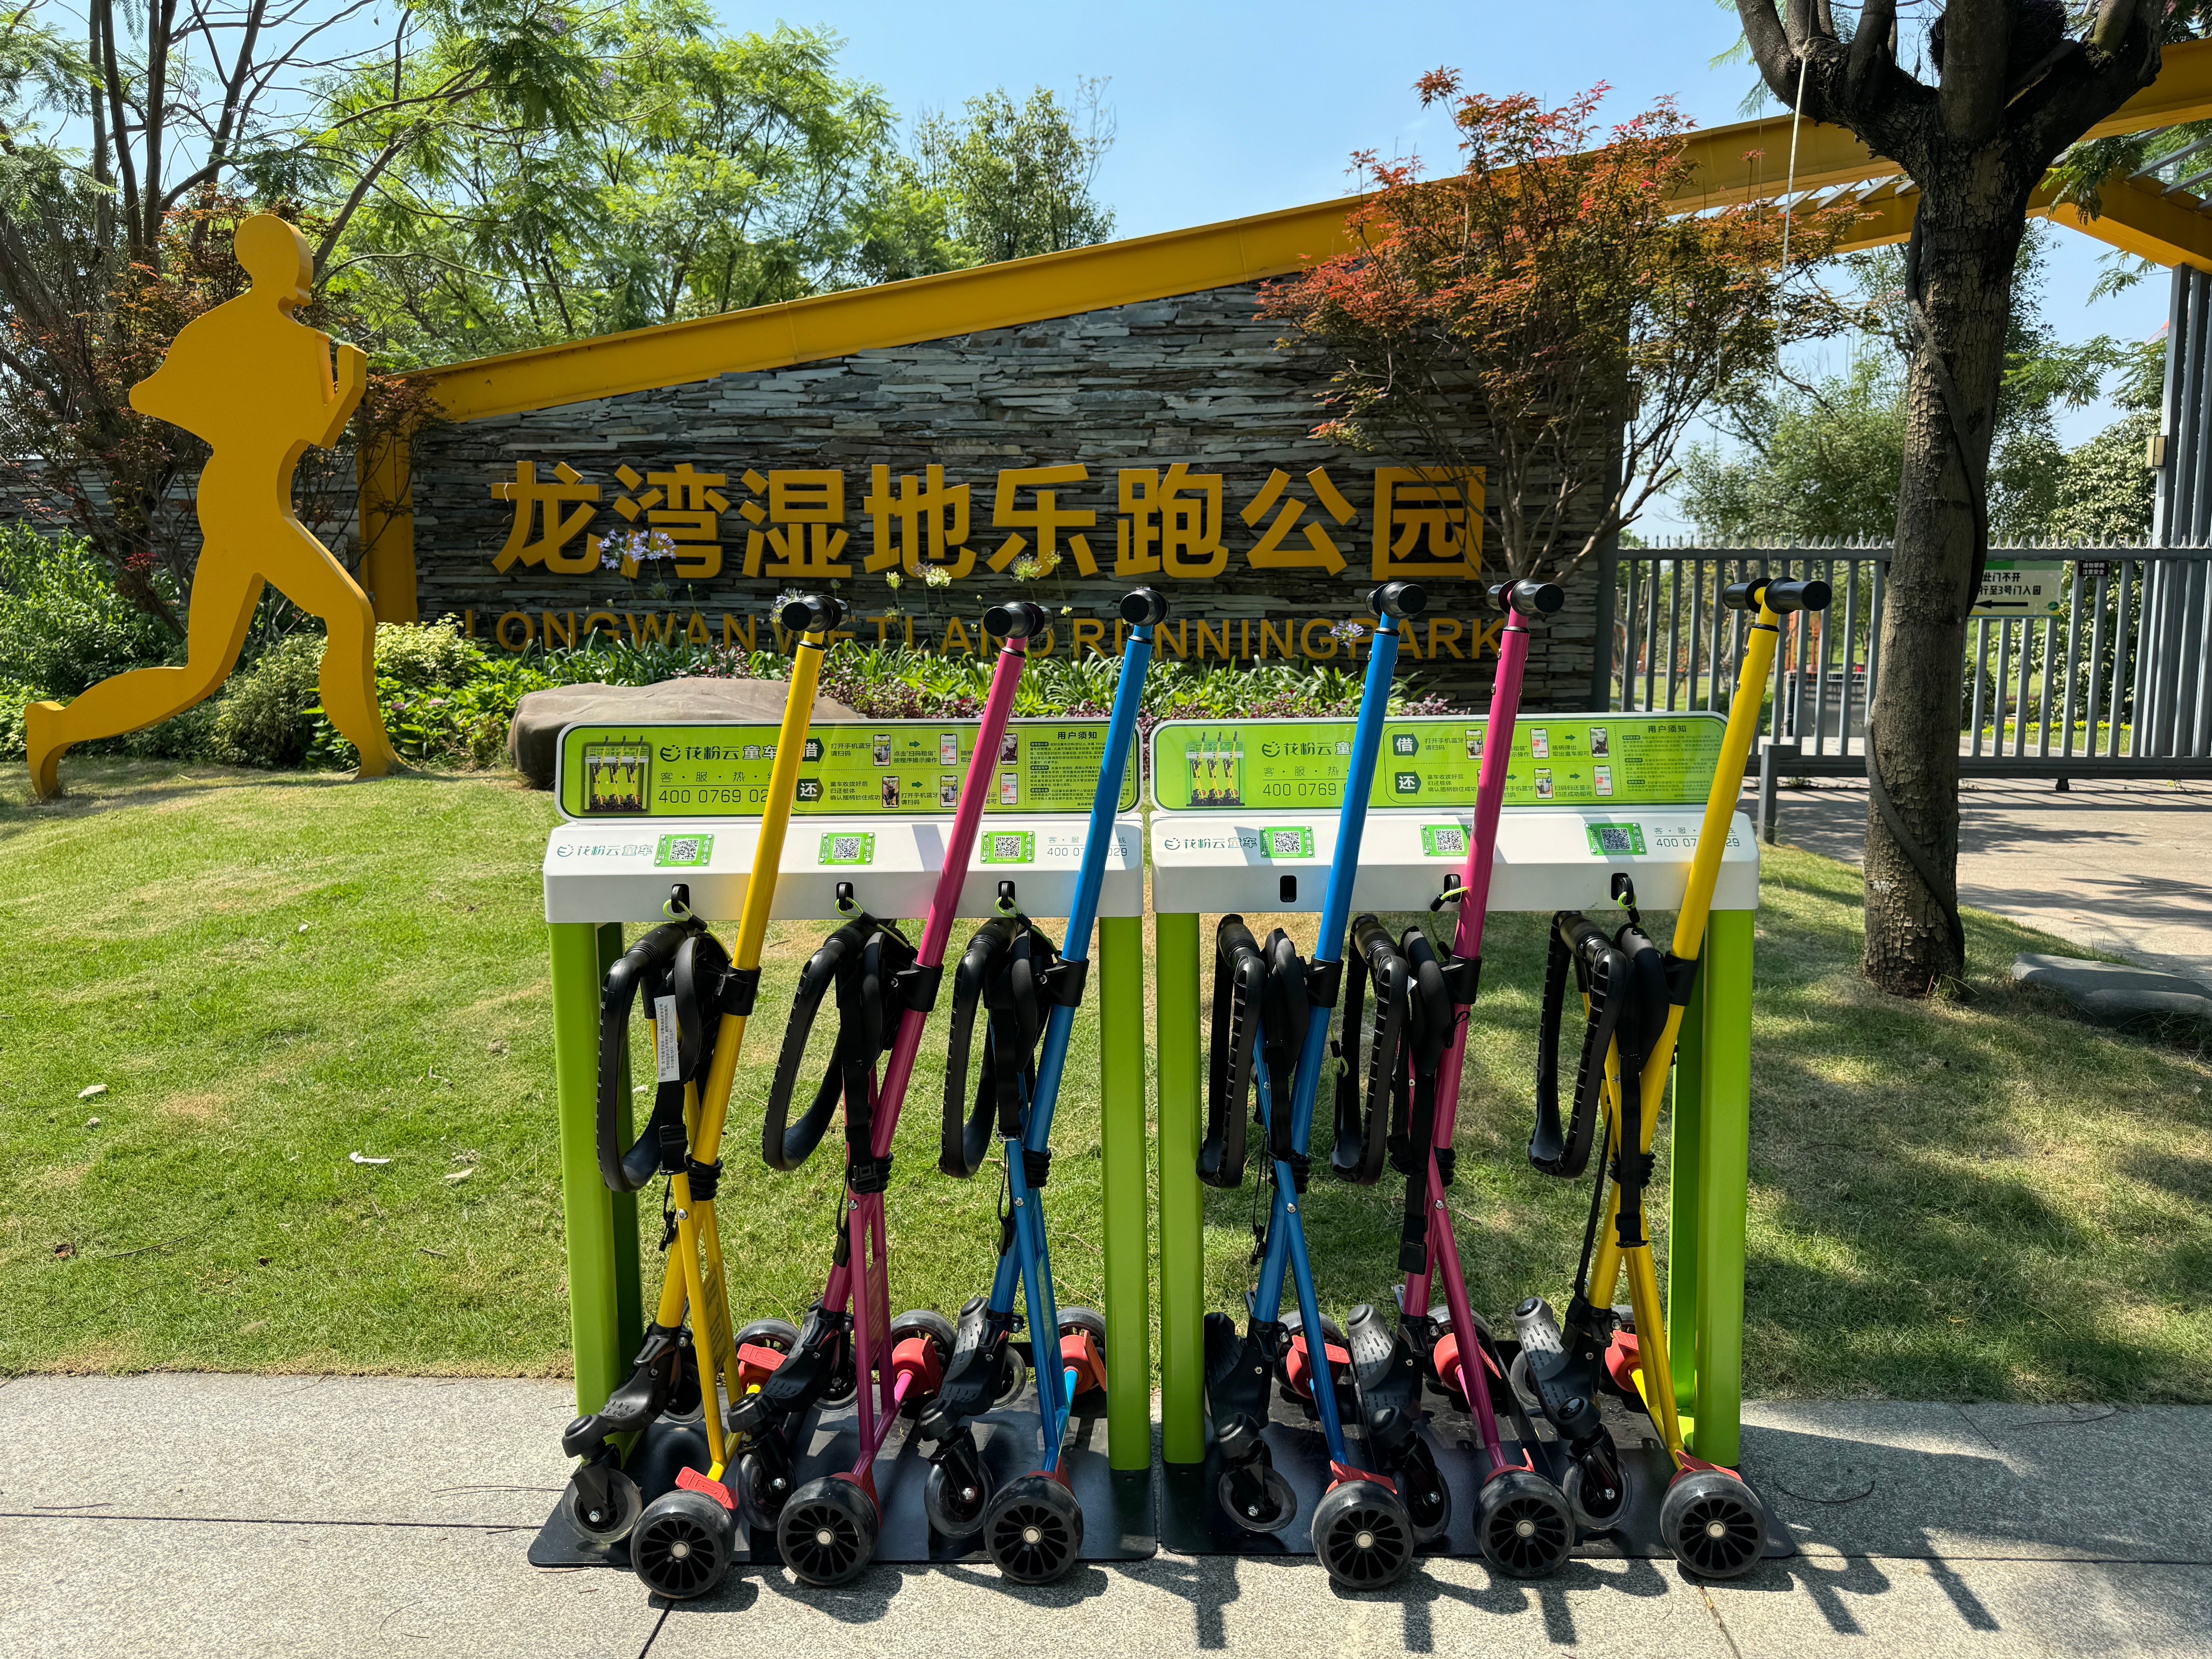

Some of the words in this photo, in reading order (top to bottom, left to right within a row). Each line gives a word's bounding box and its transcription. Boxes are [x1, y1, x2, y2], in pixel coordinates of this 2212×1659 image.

[491, 460, 1486, 581] 龙湾湿地乐跑公园
[1983, 572, 2020, 582] 此门不开
[1058, 731, 1097, 739] 用户须知
[1648, 725, 1686, 733] 用户须知
[803, 743, 818, 757] 借
[1284, 741, 1354, 755] 花粉云童
[1396, 738, 1413, 752] 借
[685, 745, 777, 761] 花粉云童车
[800, 783, 817, 797] 还
[1263, 783, 1291, 796] 400
[1298, 783, 1336, 795] 0769
[1398, 776, 1416, 790] 还
[659, 789, 690, 803] 400
[699, 789, 741, 803] 0769
[982, 836, 991, 857] 先扫码
[1183, 837, 1257, 849] 花粉云童车
[1304, 832, 1312, 851] 再借还
[1424, 830, 1432, 850] 先扫码
[1656, 838, 1678, 847] 400
[577, 845, 653, 856] 花粉云童车
[658, 840, 668, 859] 先扫码
[700, 840, 710, 859] 再借还
[821, 838, 831, 858] 先扫码
[863, 838, 872, 858] 再借还
[1047, 848, 1068, 856] 400
